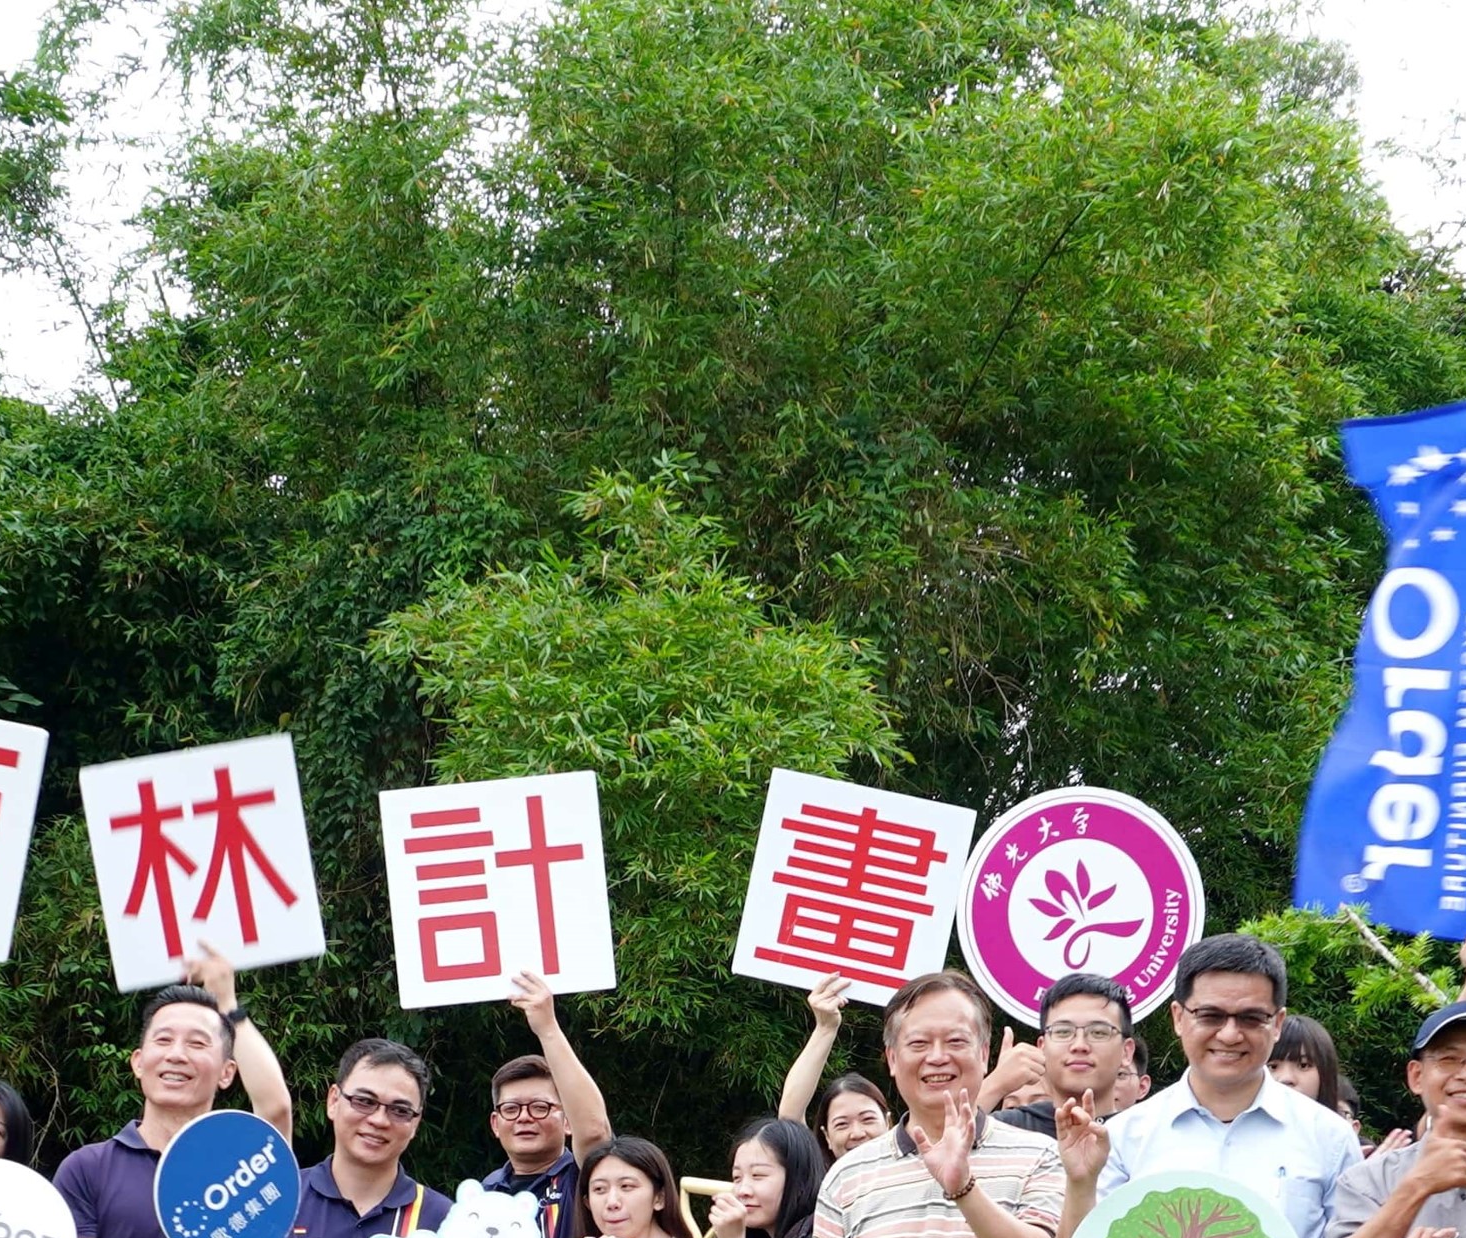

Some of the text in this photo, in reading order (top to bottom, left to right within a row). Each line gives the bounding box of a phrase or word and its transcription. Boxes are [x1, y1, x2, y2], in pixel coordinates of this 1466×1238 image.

[109, 767, 298, 959] 林
[404, 795, 583, 983] 計
[753, 803, 948, 990] 畫
[1134, 888, 1182, 988] University
